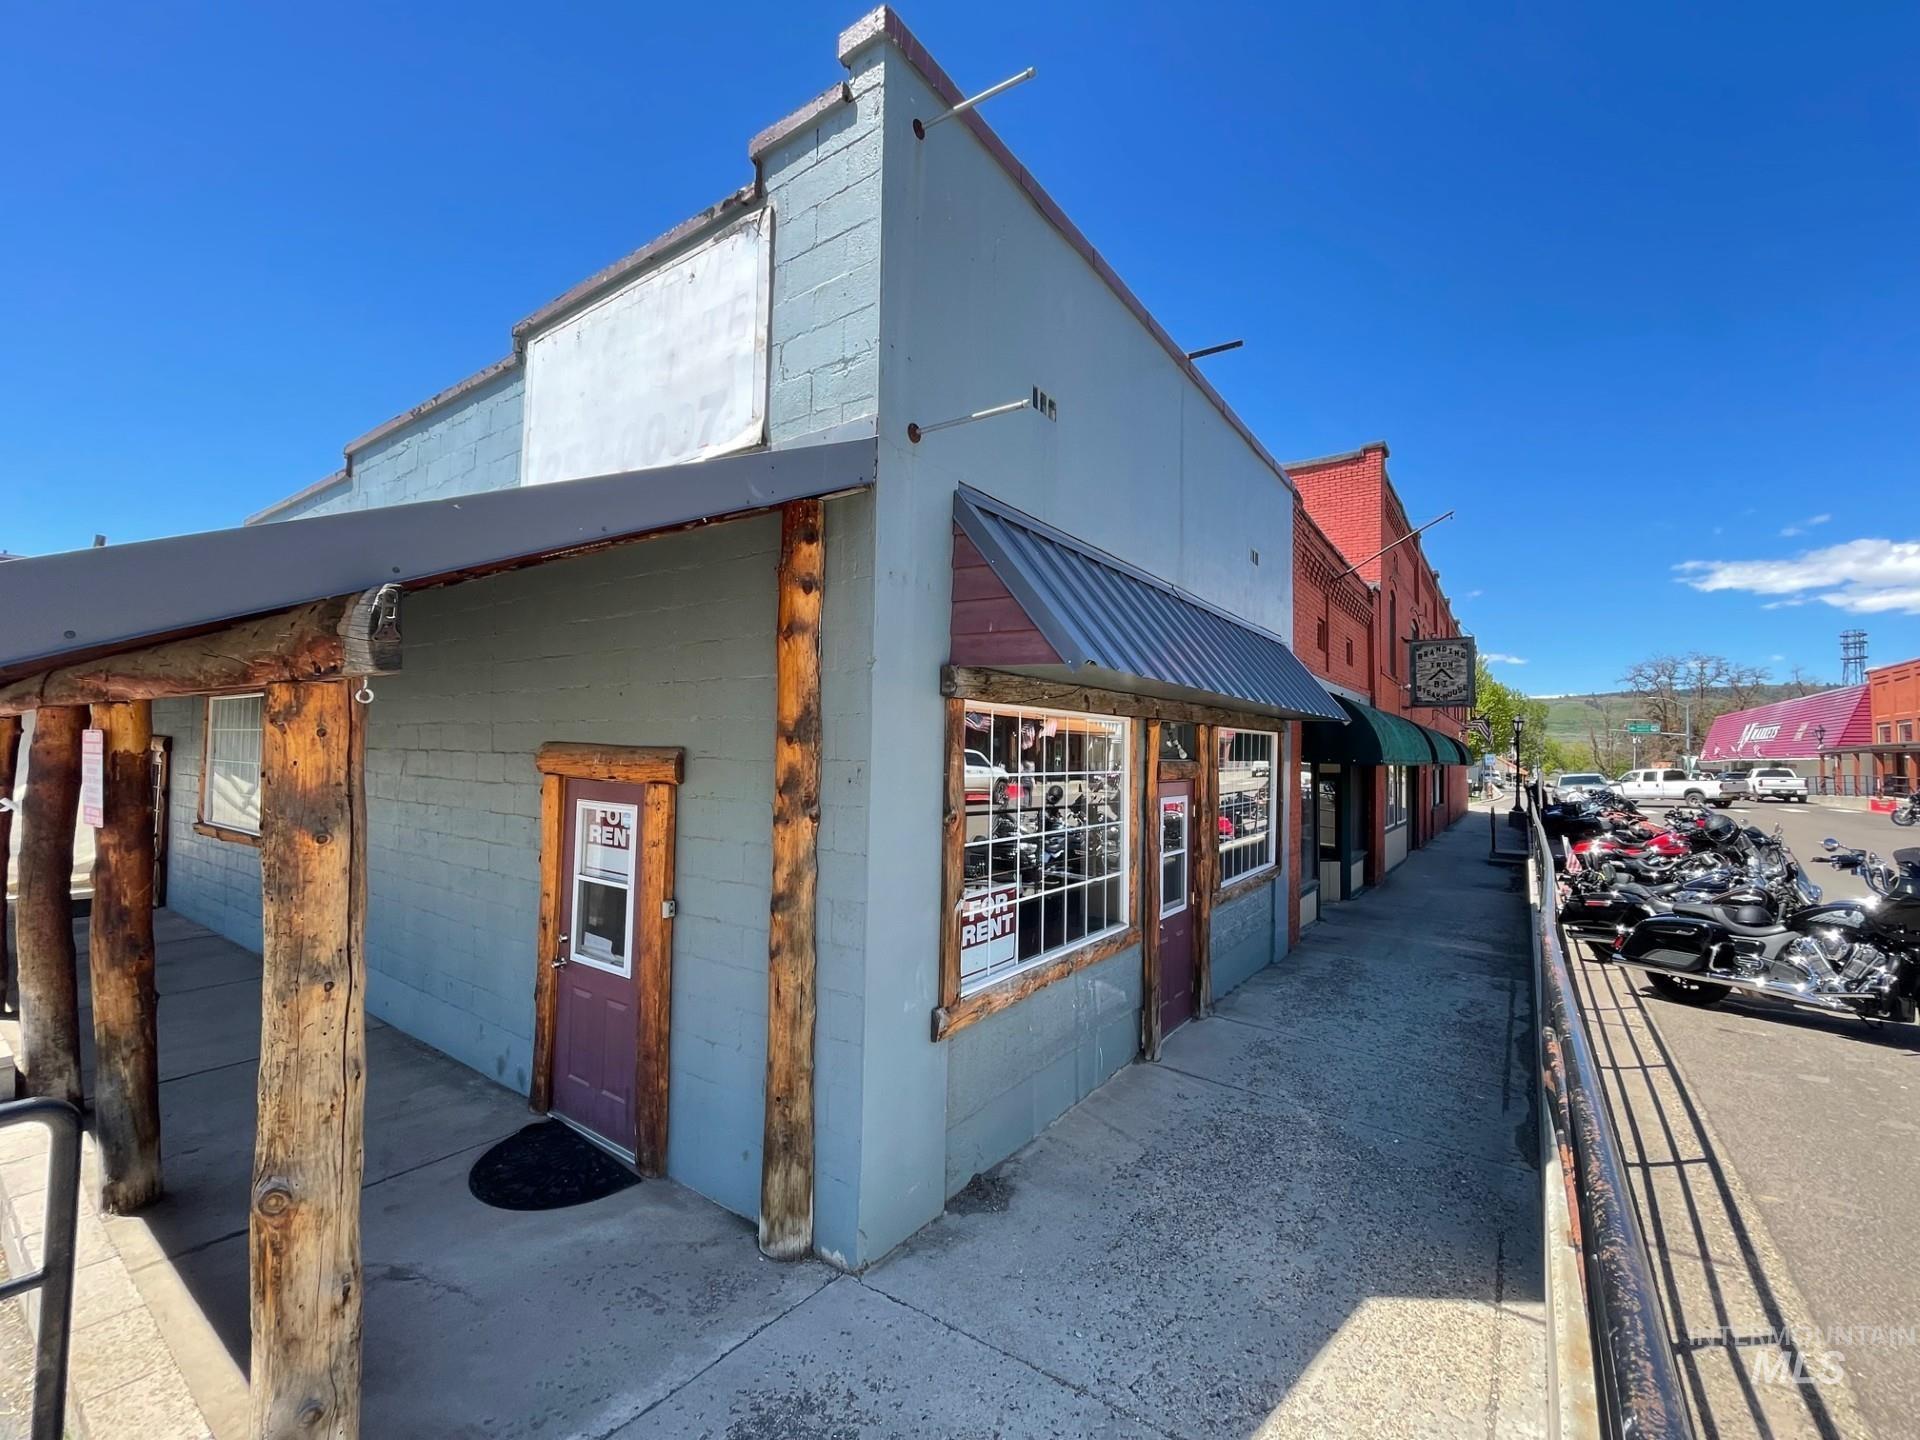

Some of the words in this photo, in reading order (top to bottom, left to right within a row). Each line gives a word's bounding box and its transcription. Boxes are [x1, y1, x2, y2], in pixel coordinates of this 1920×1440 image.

[1417, 646, 1466, 659] BRANDING
[589, 824, 631, 847] REN
[968, 893, 1008, 922] FOR
[962, 912, 1014, 947] RENT
